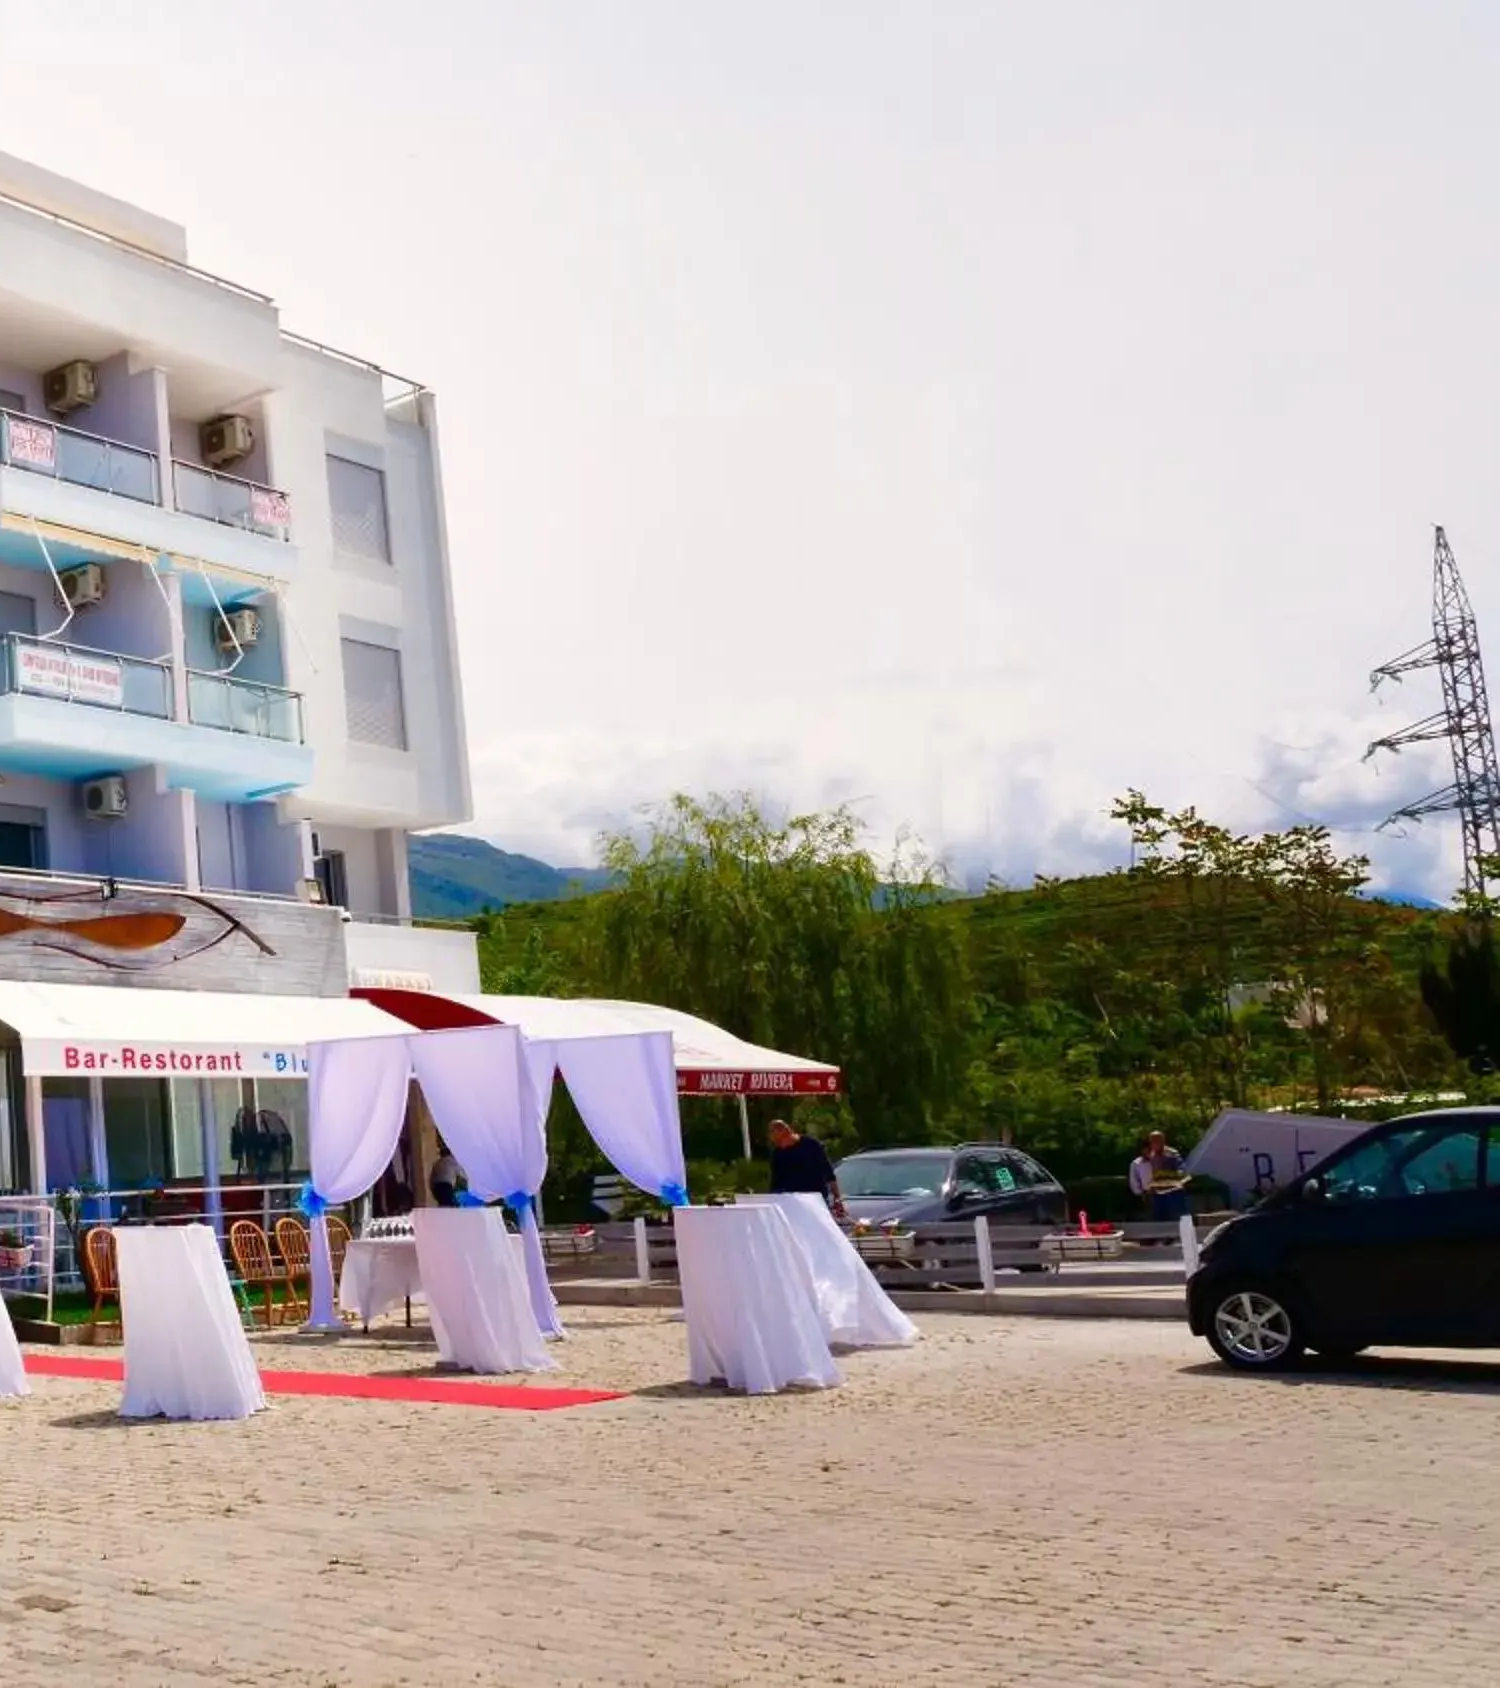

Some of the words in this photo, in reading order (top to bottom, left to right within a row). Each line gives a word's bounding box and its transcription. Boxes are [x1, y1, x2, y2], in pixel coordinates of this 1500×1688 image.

[64, 1046, 242, 1071] Bar-Restorant
[700, 1072, 745, 1091] MARKET
[751, 1072, 794, 1091] RIVIERA
